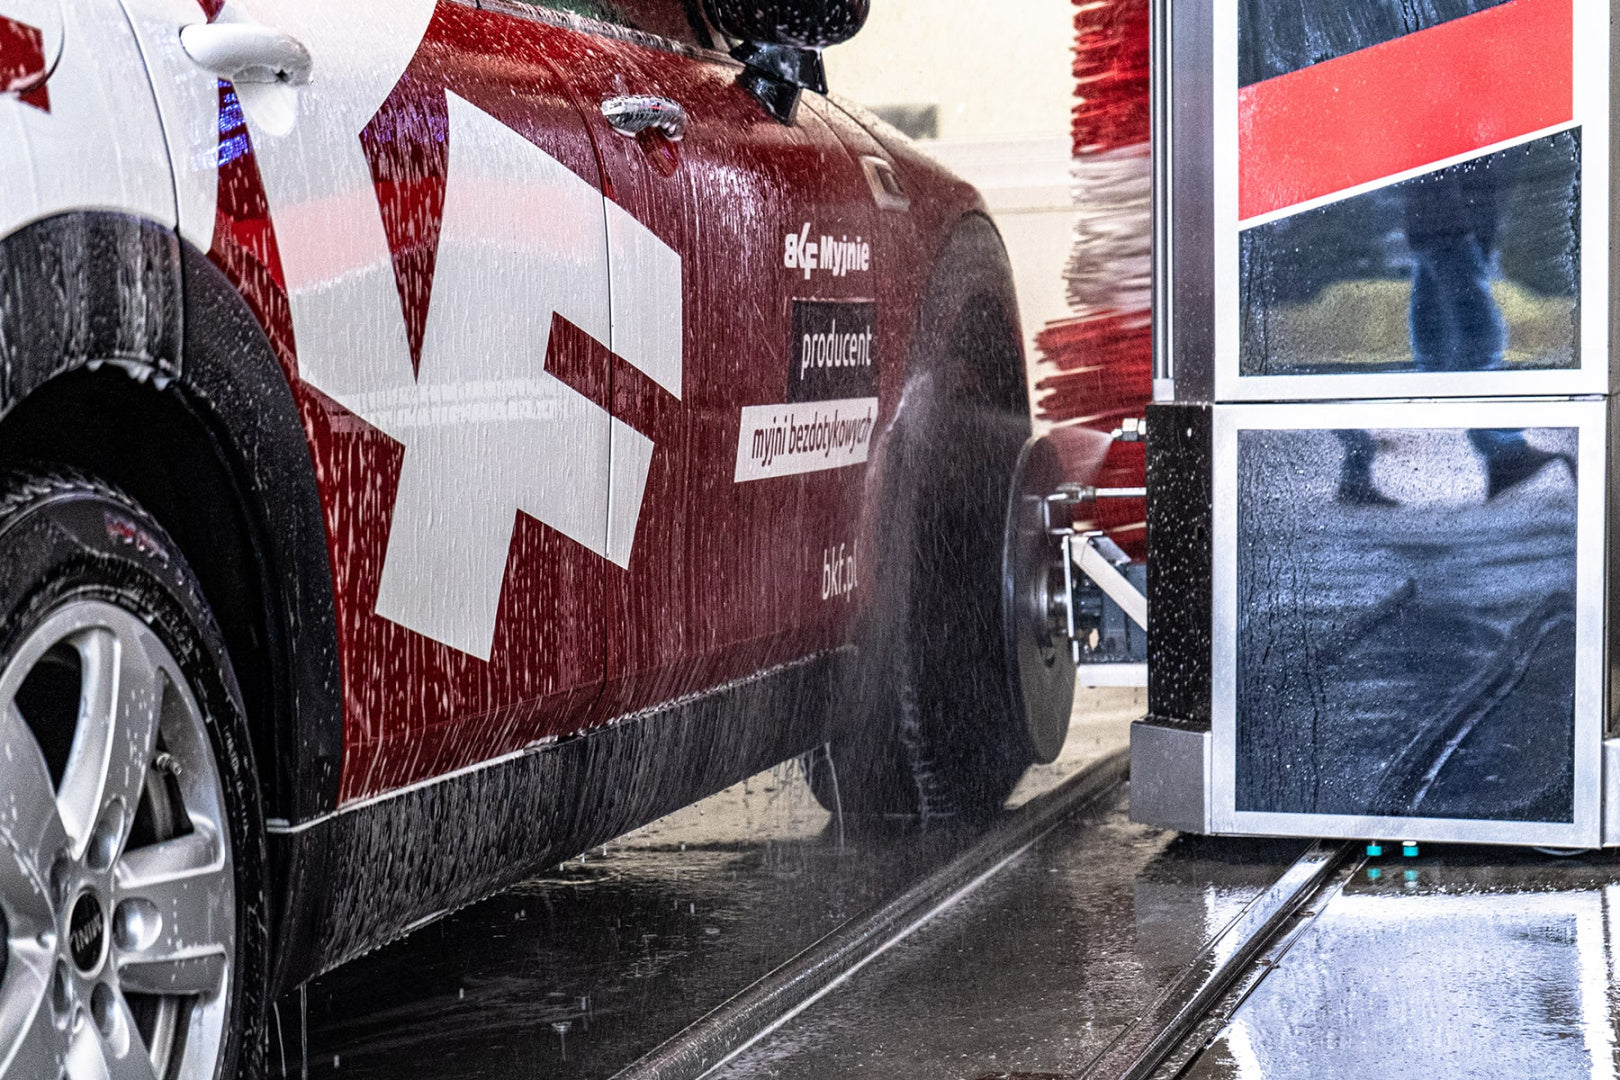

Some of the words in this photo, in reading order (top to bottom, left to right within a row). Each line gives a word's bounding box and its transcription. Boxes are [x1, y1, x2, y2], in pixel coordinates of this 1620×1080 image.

[820, 235, 870, 277] Myjnie
[801, 319, 872, 380] producent
[751, 415, 788, 467] myjni
[788, 406, 872, 458] bezdotykowych
[822, 538, 858, 603] bkf.pl
